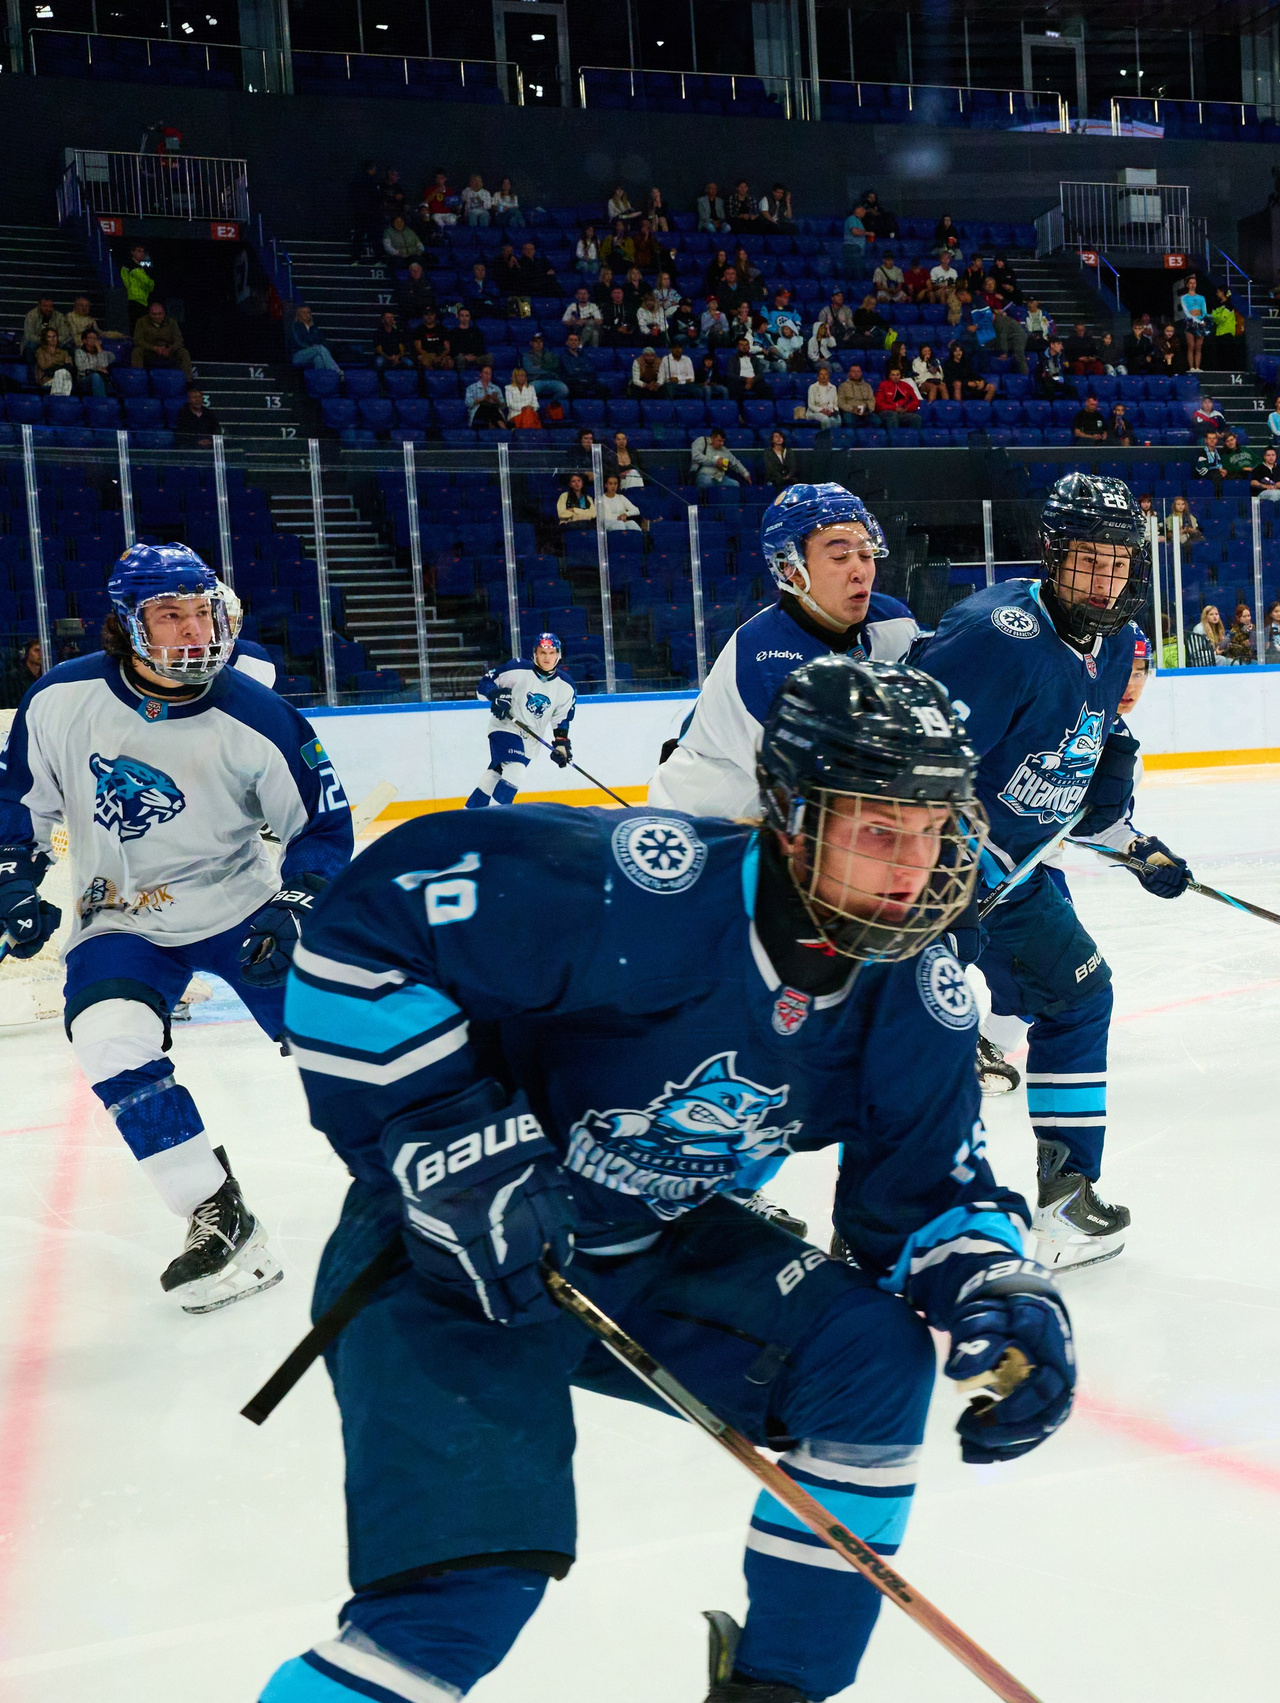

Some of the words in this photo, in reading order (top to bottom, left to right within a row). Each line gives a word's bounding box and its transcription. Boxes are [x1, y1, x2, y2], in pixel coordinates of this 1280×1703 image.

[217, 225, 236, 238] E2
[1168, 256, 1183, 267] E3
[370, 269, 385, 280] 18
[377, 294, 392, 304] 17
[1268, 308, 1279, 318] 17
[249, 367, 264, 379] 14
[1230, 374, 1243, 385] 14
[265, 396, 282, 409] 13
[1252, 400, 1266, 411] 13
[281, 427, 297, 440] 12
[1102, 493, 1128, 511] 26
[768, 649, 804, 662] Halyk
[910, 706, 953, 738] 19
[618, 1143, 727, 1174] СИБИРСКИЕ
